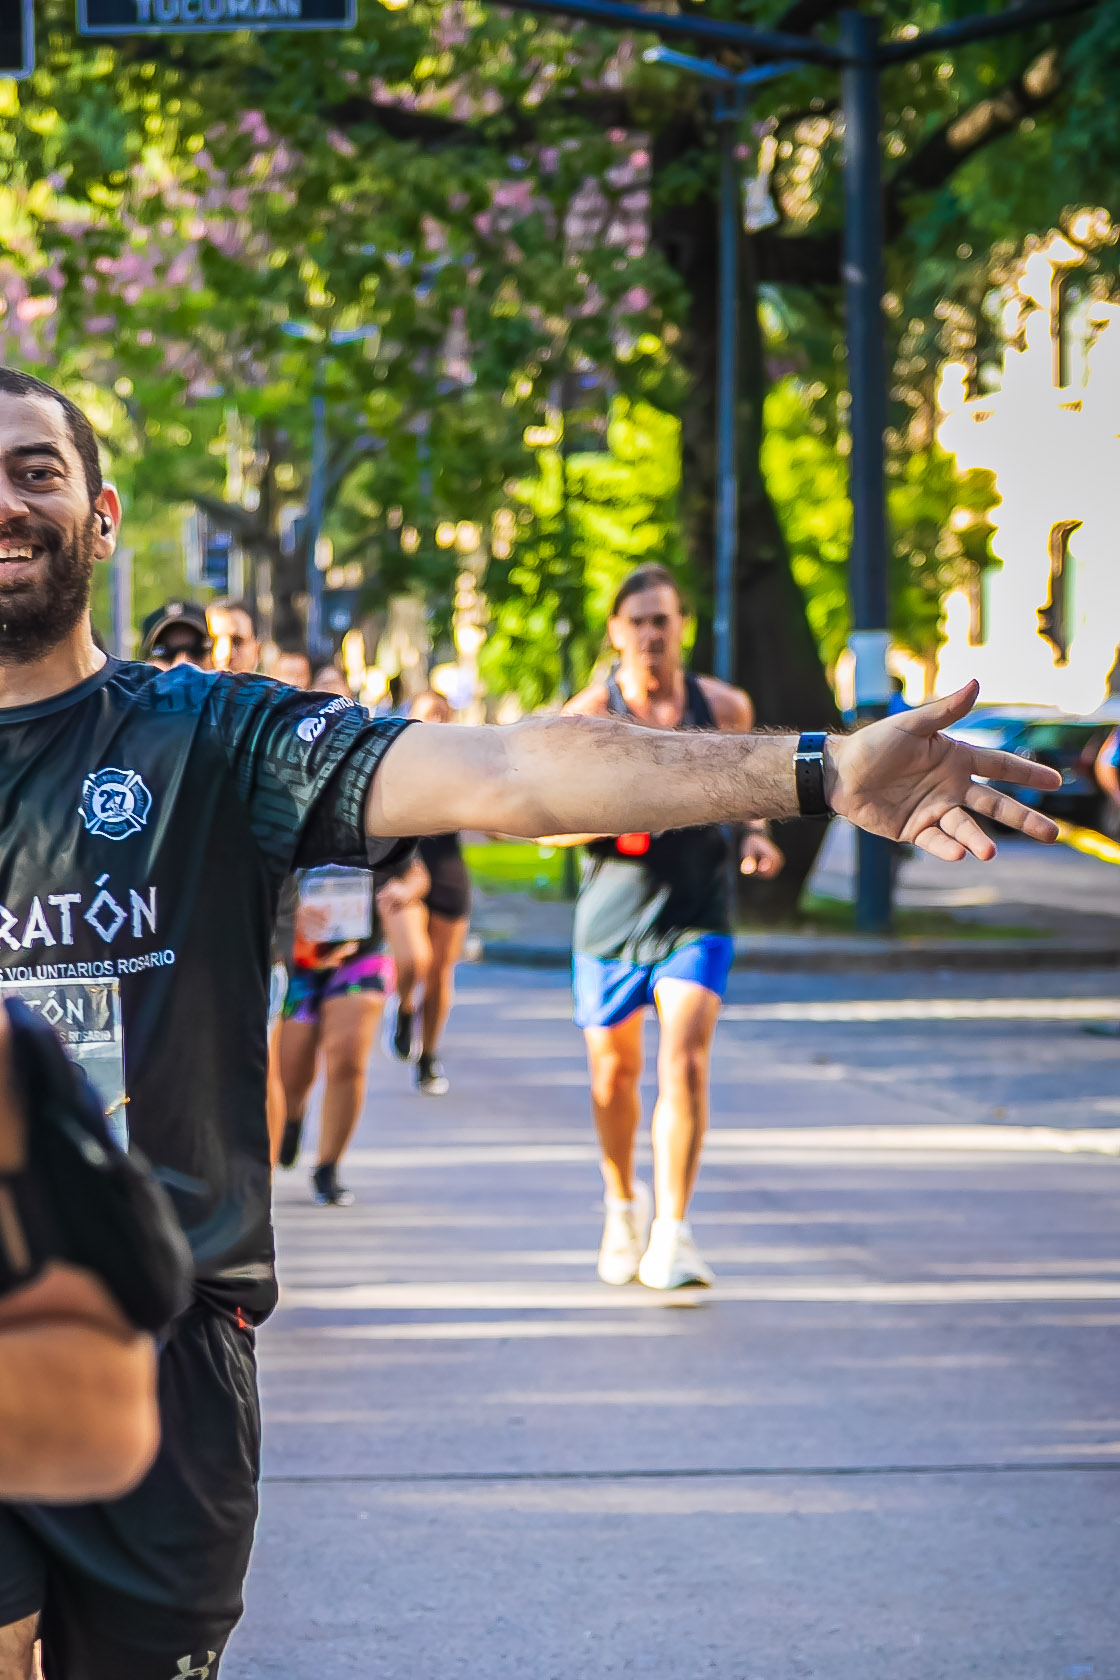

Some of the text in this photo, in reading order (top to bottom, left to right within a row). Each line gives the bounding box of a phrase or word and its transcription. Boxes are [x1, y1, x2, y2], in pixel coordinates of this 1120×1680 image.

[99, 789, 127, 813] 27
[5, 960, 114, 981] VOLUNTARIOS
[117, 949, 175, 974] ROSARIO
